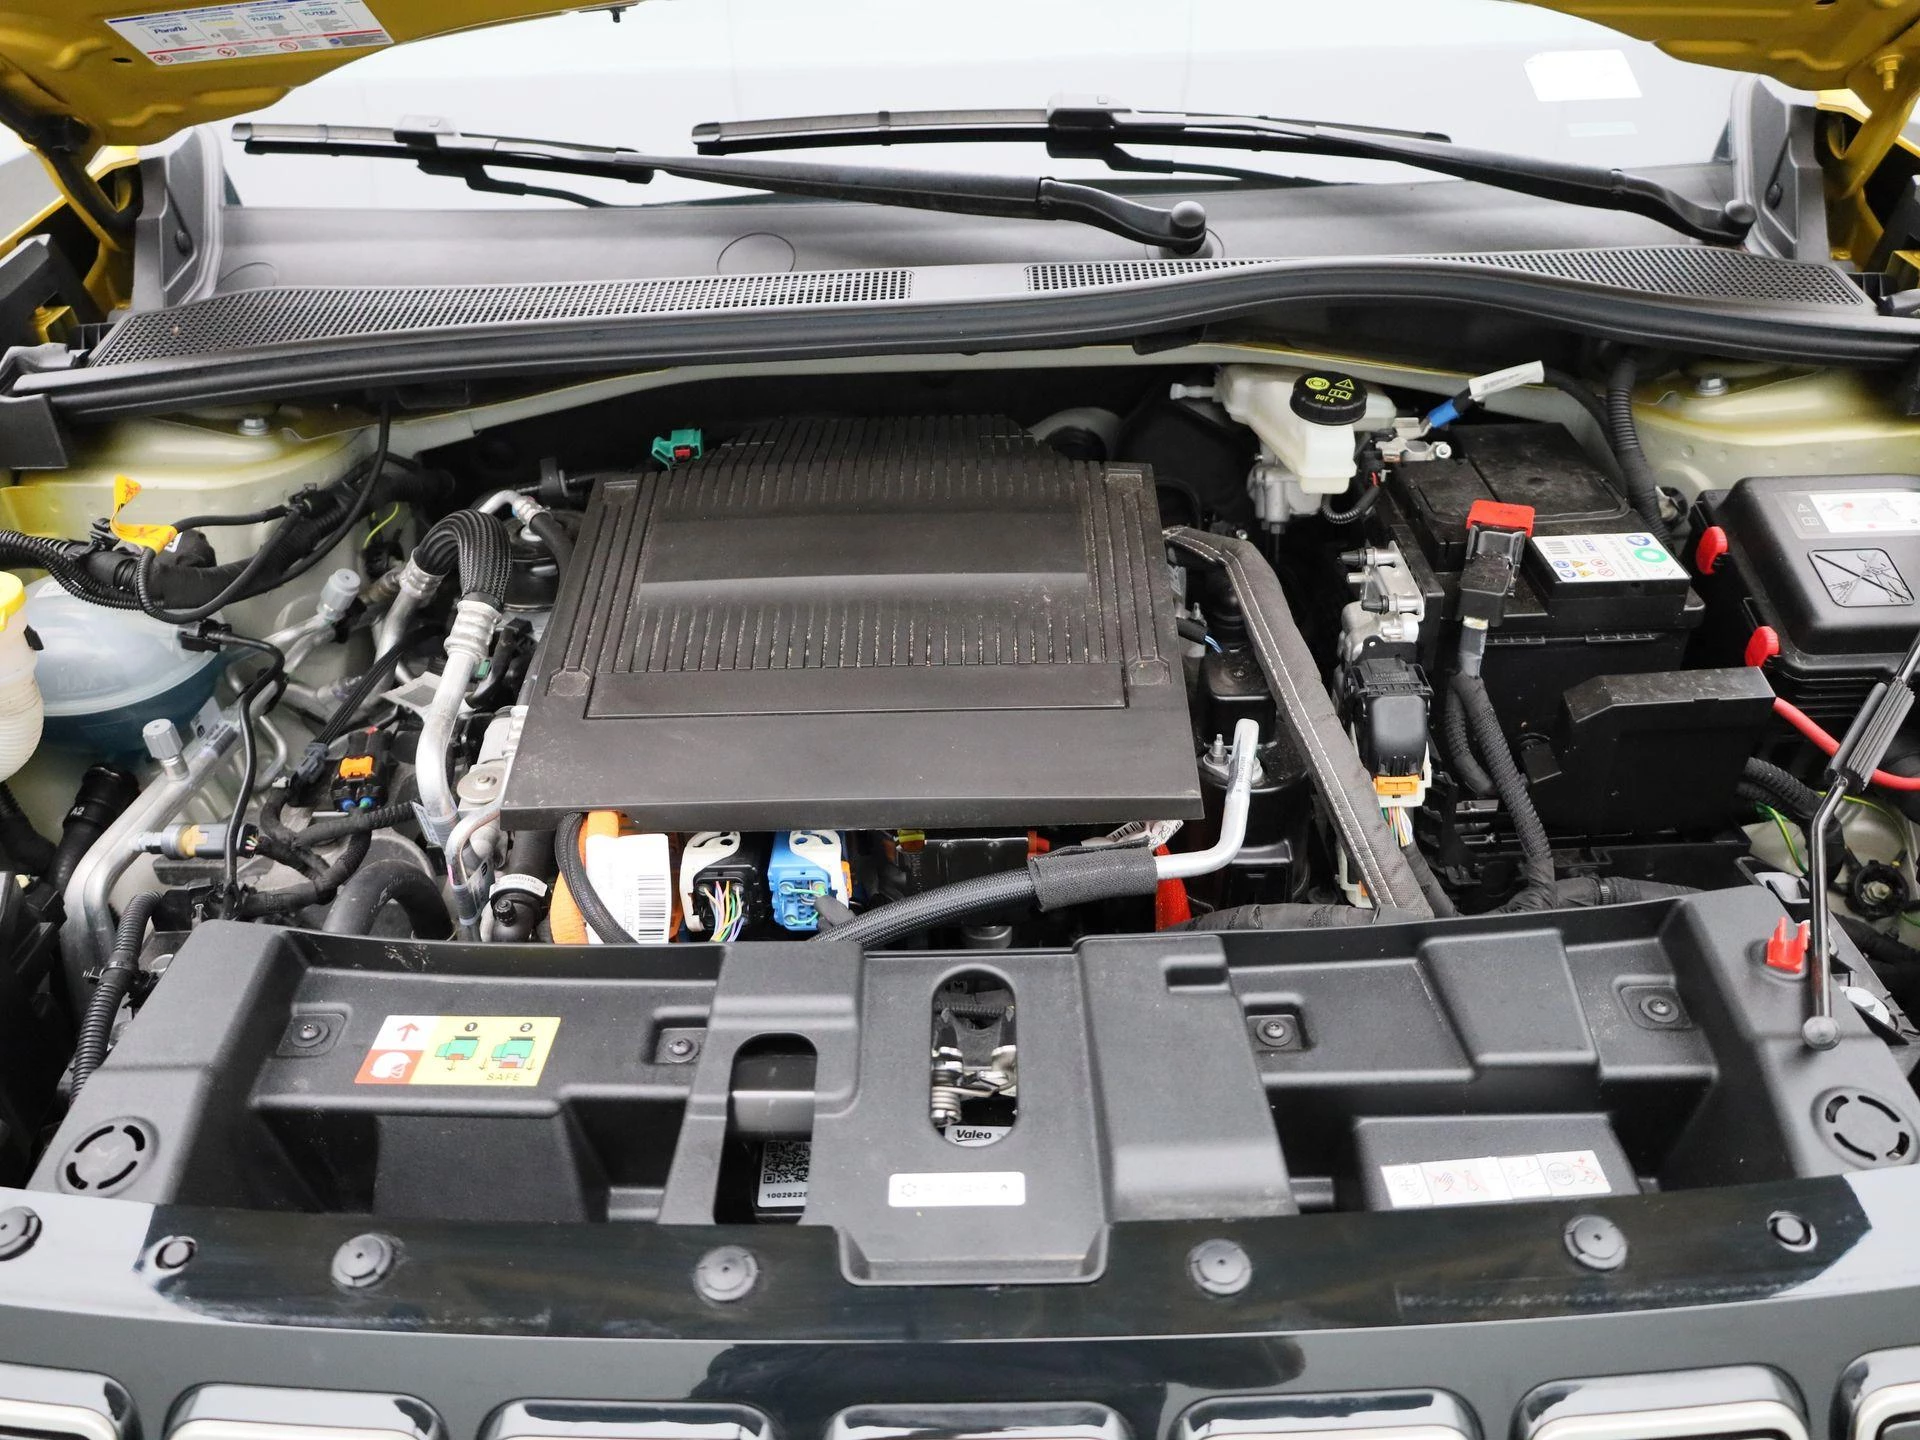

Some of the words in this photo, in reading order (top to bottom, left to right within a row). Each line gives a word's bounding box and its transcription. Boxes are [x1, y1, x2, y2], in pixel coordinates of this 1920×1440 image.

[153, 26, 188, 34] Paraflu
[70, 806, 85, 816] A2
[486, 1072, 521, 1081] SAFE
[956, 1129, 992, 1140] Valeo
